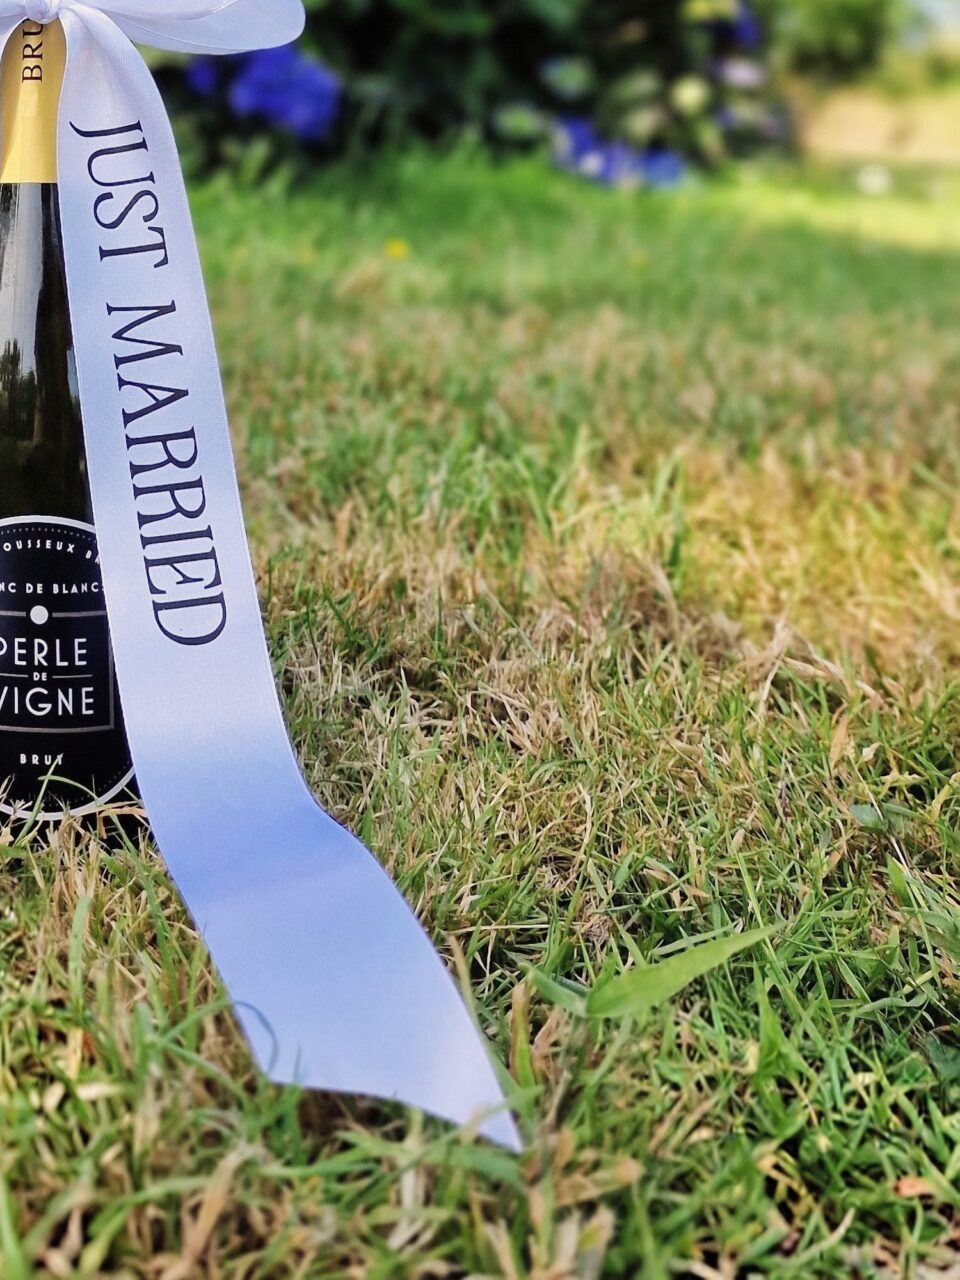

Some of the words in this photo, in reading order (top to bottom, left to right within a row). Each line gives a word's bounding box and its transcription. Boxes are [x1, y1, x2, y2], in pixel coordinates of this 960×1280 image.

[69, 119, 170, 269] JUST
[105, 299, 228, 646] MARRIED
[25, 582, 43, 594] DE
[52, 581, 104, 594] BLANC
[33, 671, 48, 682] DE
[19, 753, 63, 766] BRUT
